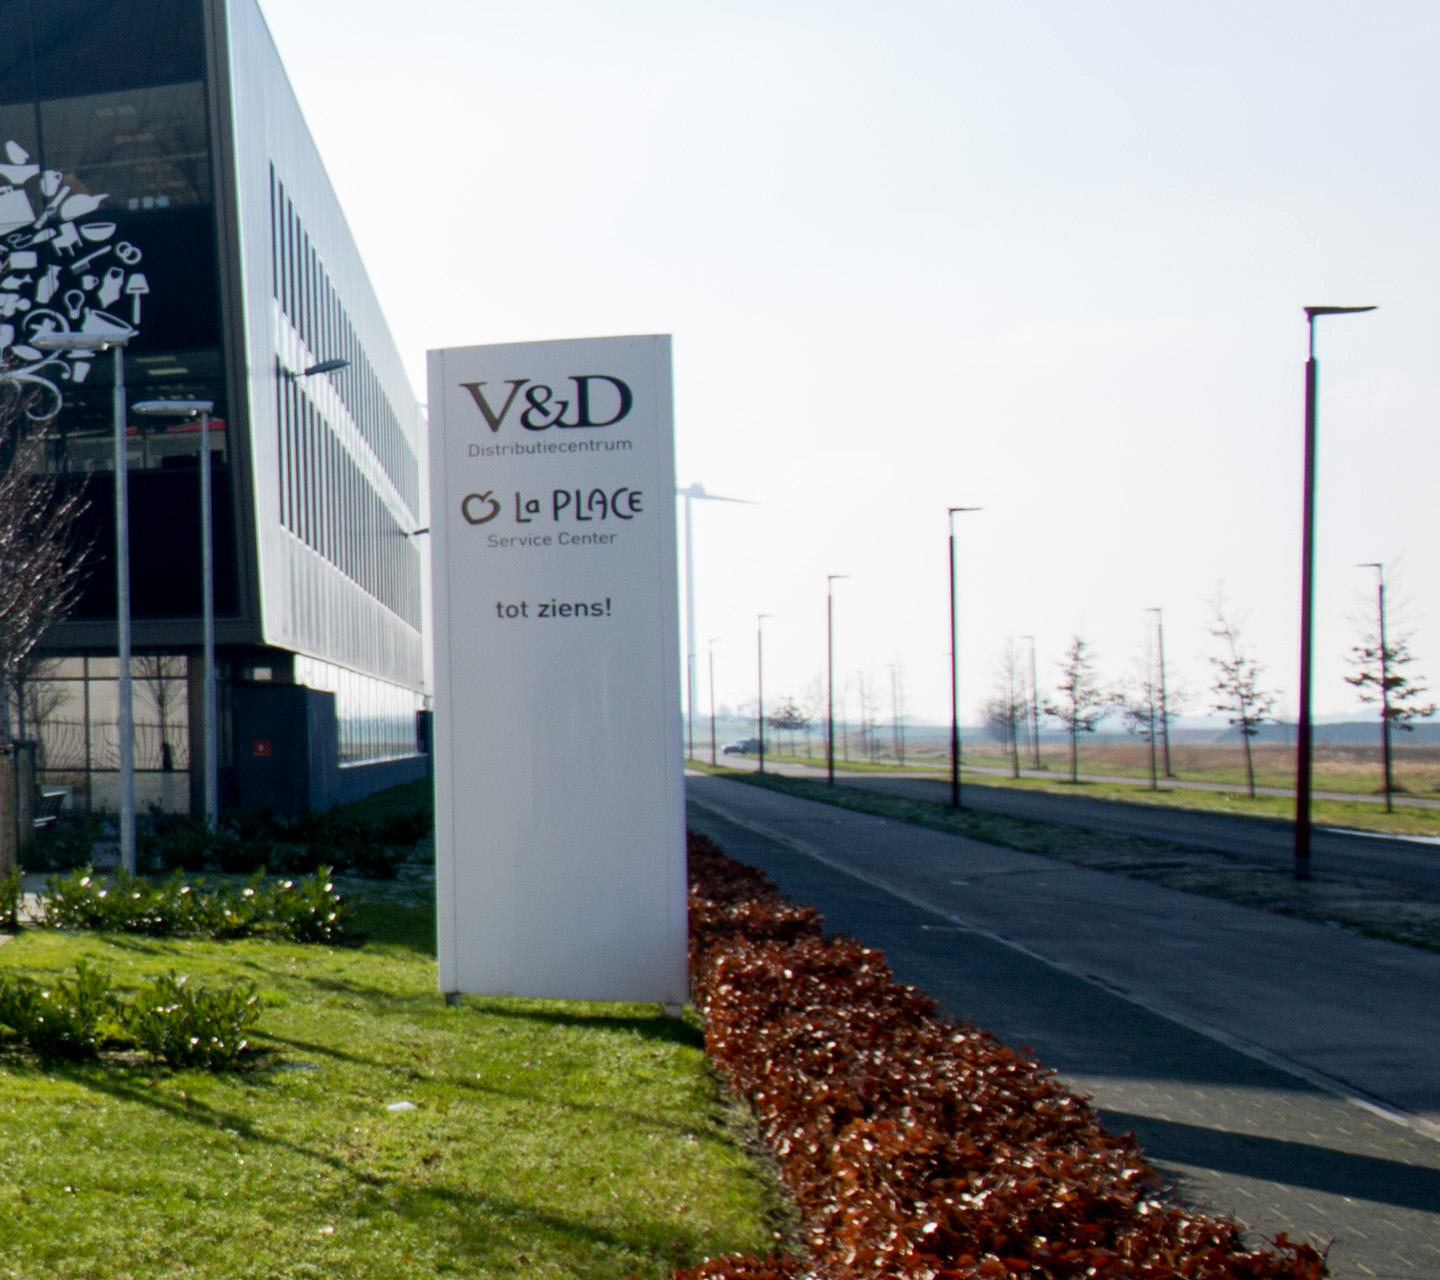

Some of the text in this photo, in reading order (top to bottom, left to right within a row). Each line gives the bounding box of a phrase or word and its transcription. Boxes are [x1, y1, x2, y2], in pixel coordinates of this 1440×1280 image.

[459, 374, 634, 433] V&D
[468, 438, 633, 458] Distributiecentrum
[515, 487, 644, 523] La PLACE
[487, 531, 618, 549] Service Center
[496, 597, 613, 619] tot ziens!
